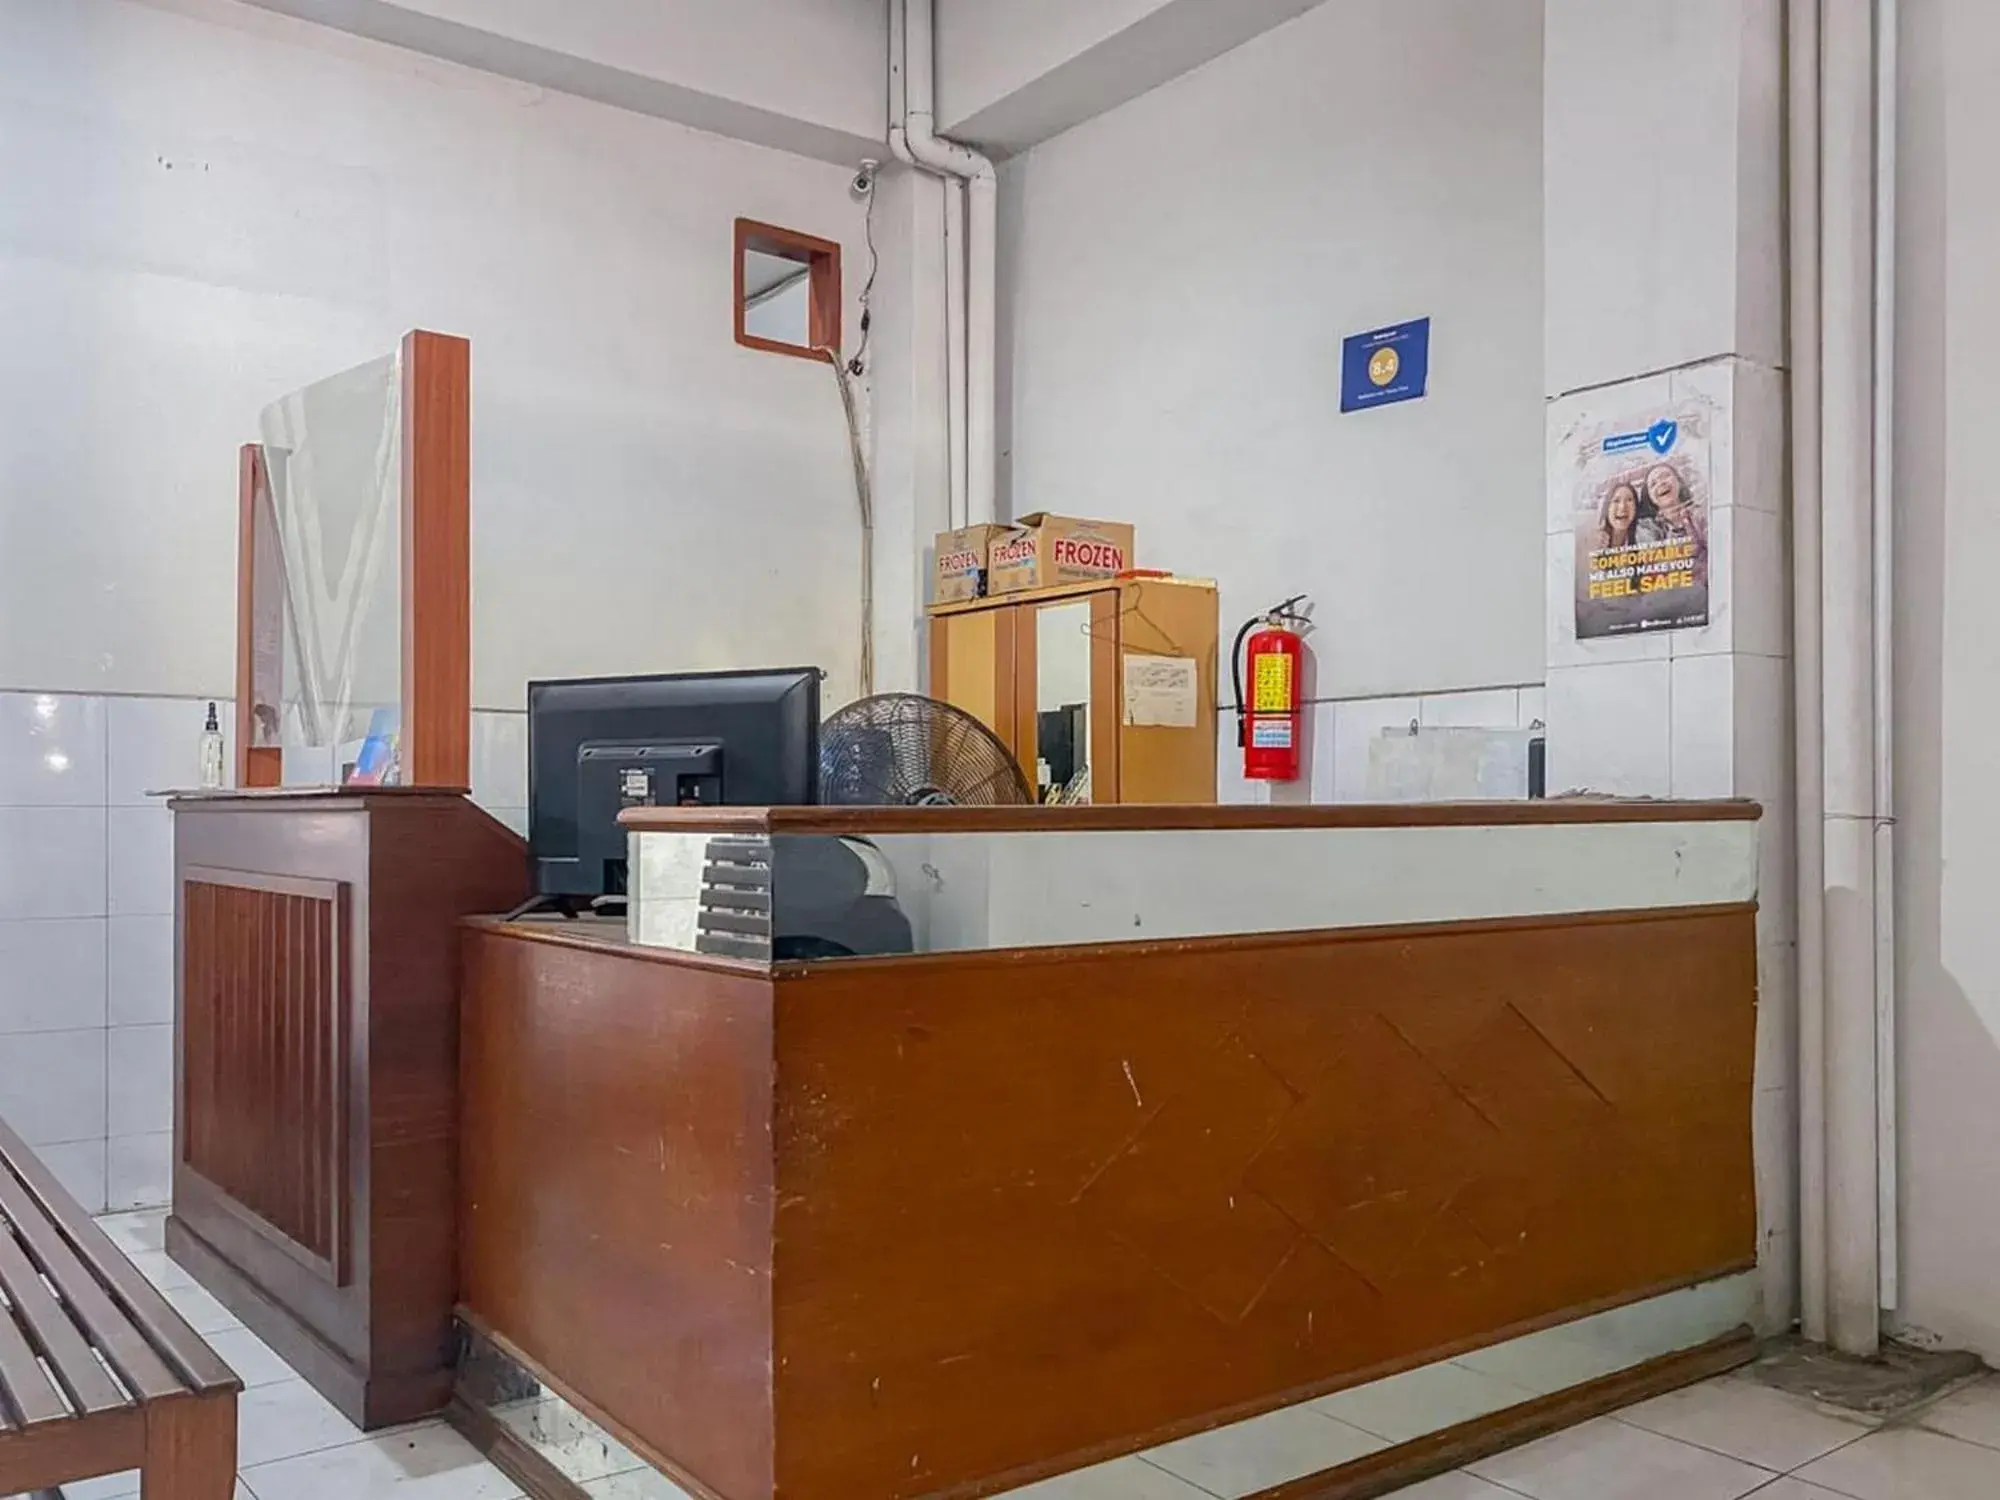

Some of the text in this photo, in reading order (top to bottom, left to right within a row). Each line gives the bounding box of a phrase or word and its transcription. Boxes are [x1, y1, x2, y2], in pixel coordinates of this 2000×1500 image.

[940, 552, 978, 570] FROZEN
[995, 540, 1037, 561] FROZEN
[1055, 540, 1123, 570] FROZEN
[1589, 544, 1693, 569] COMFORTABLE
[1606, 567, 1635, 578] ALSO
[1637, 561, 1668, 574] MAKE
[1670, 558, 1694, 571] YOU
[1589, 570, 1693, 599] FEEL SAFE
